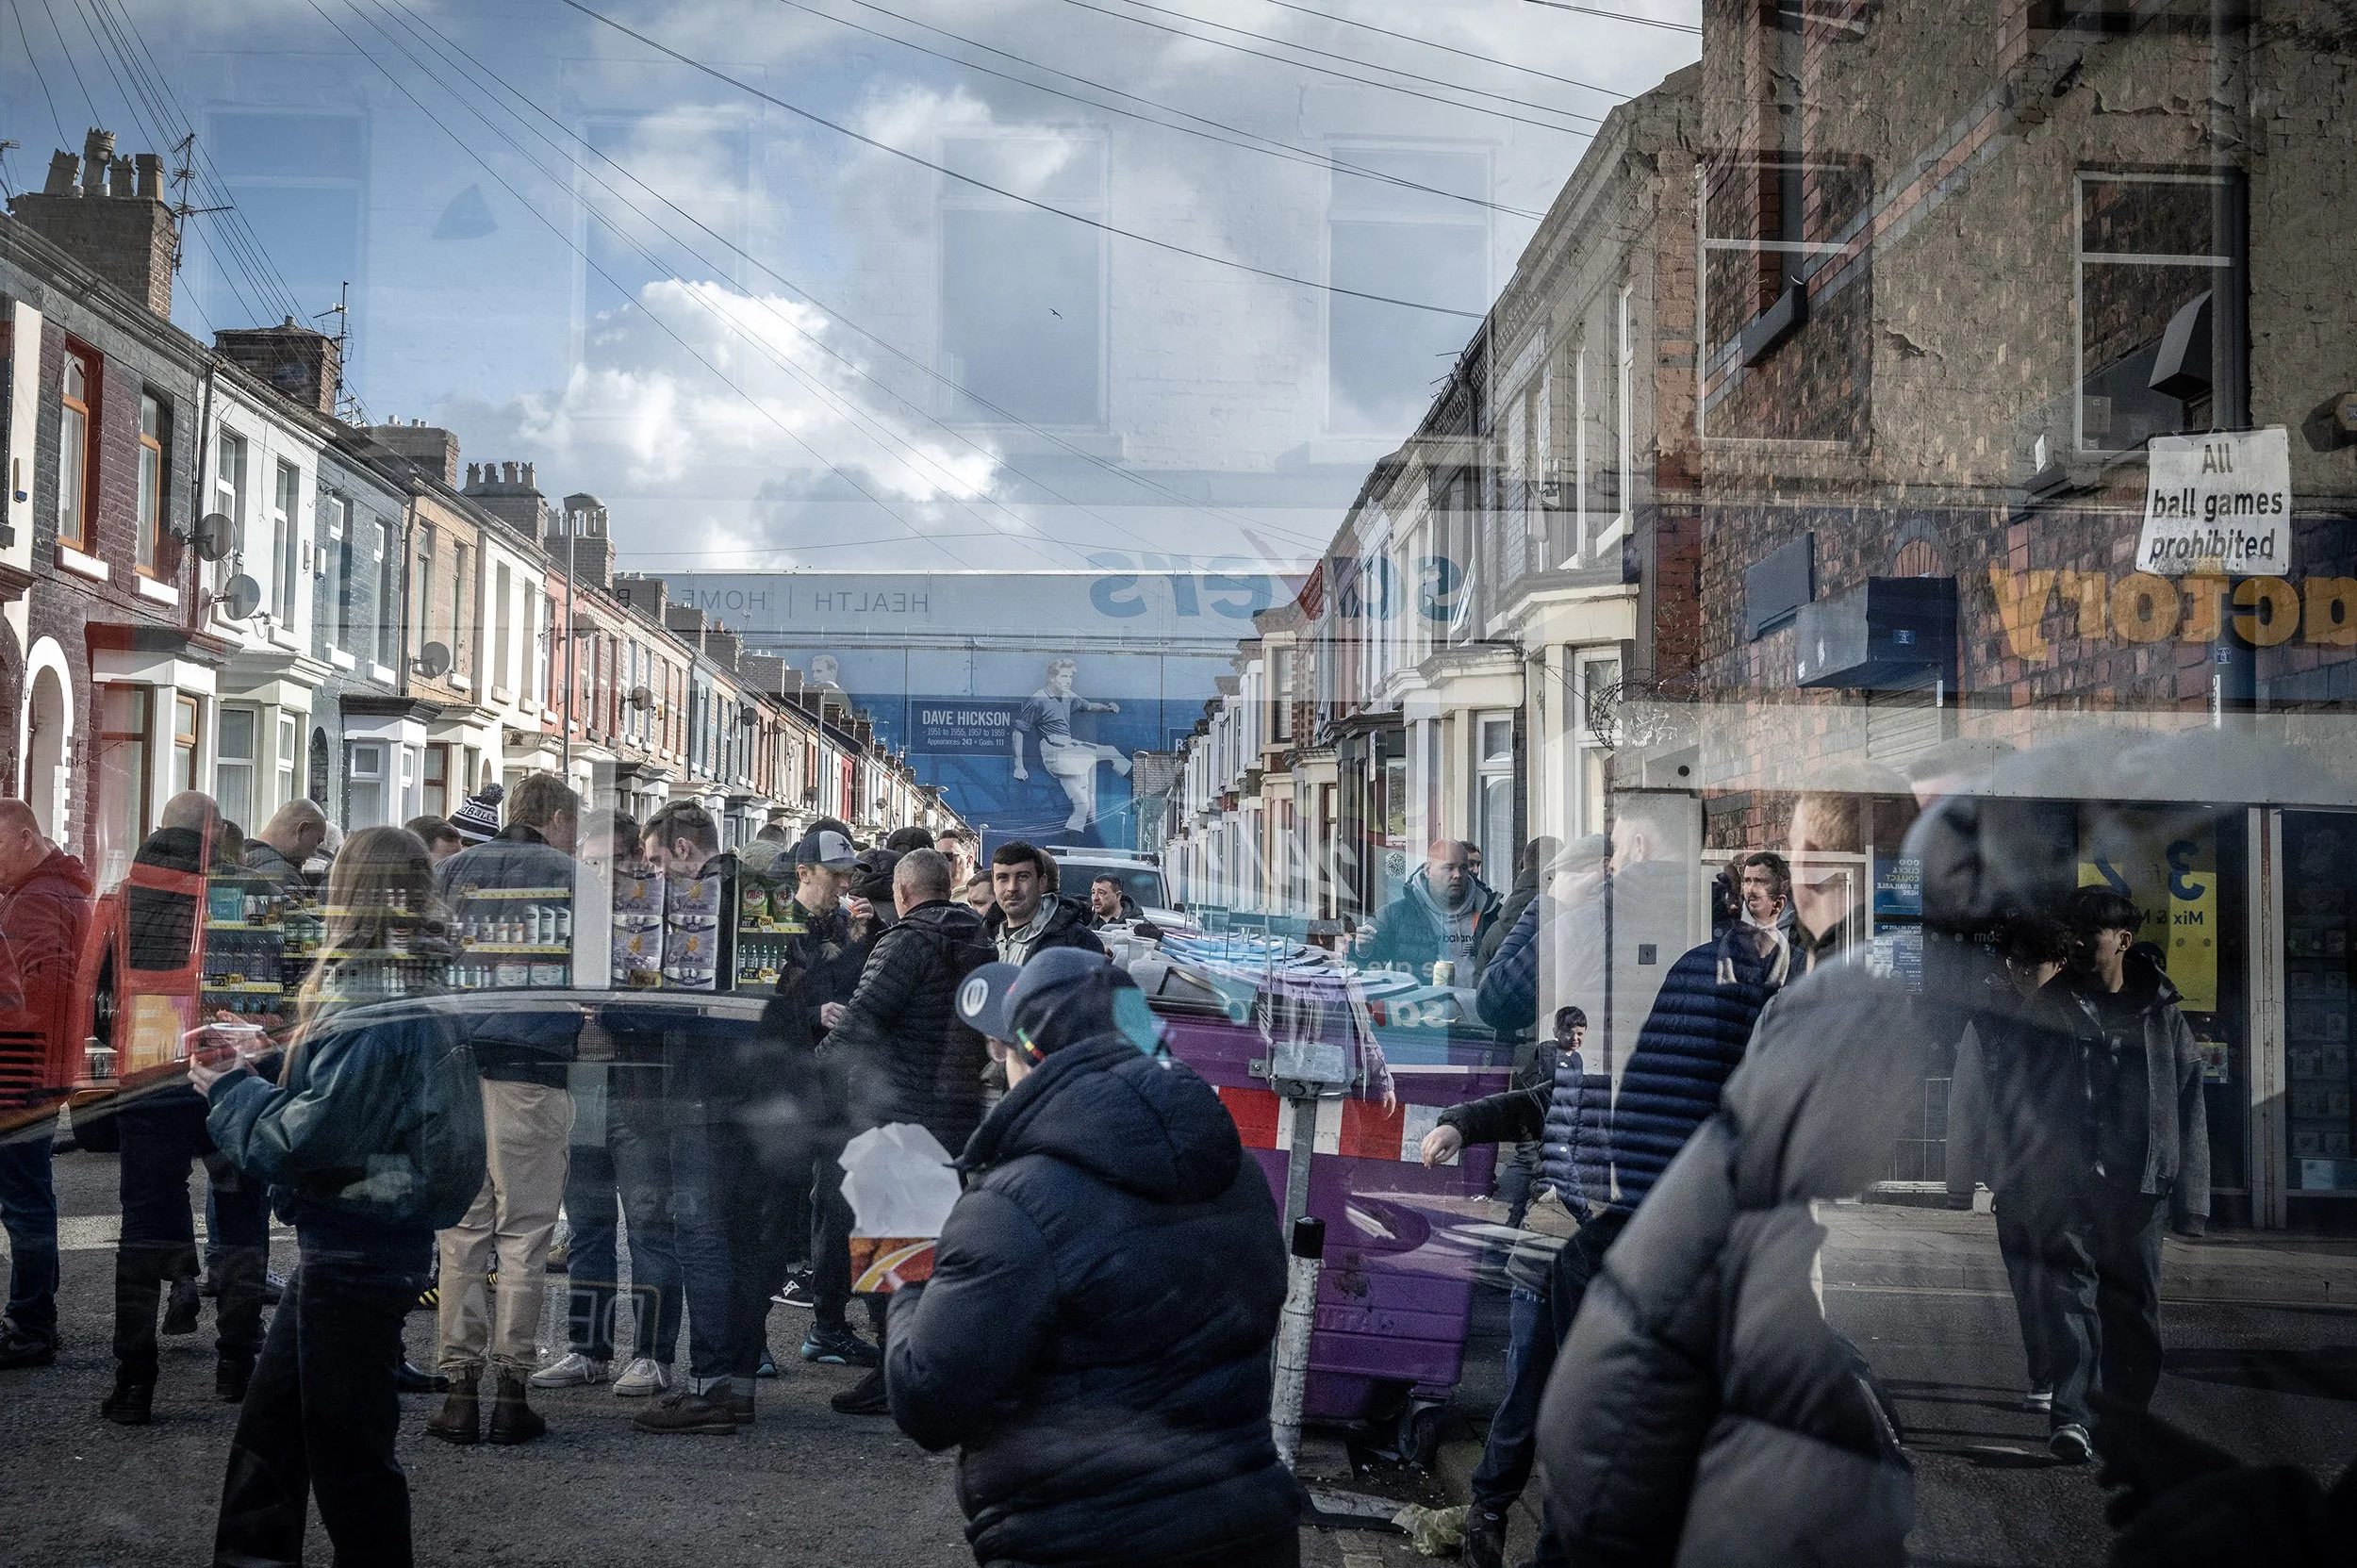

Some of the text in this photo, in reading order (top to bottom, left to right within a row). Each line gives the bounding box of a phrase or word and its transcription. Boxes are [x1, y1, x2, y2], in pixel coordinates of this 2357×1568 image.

[2200, 442, 2234, 476] All
[2152, 488, 2283, 522] ball games
[2148, 528, 2277, 566] prohibited
[922, 710, 1011, 727] DAVE HICKSON
[927, 727, 941, 735] 1951
[943, 728, 949, 736] to
[991, 729, 1006, 737] 1959
[1287, 1080, 1326, 1098] 37
